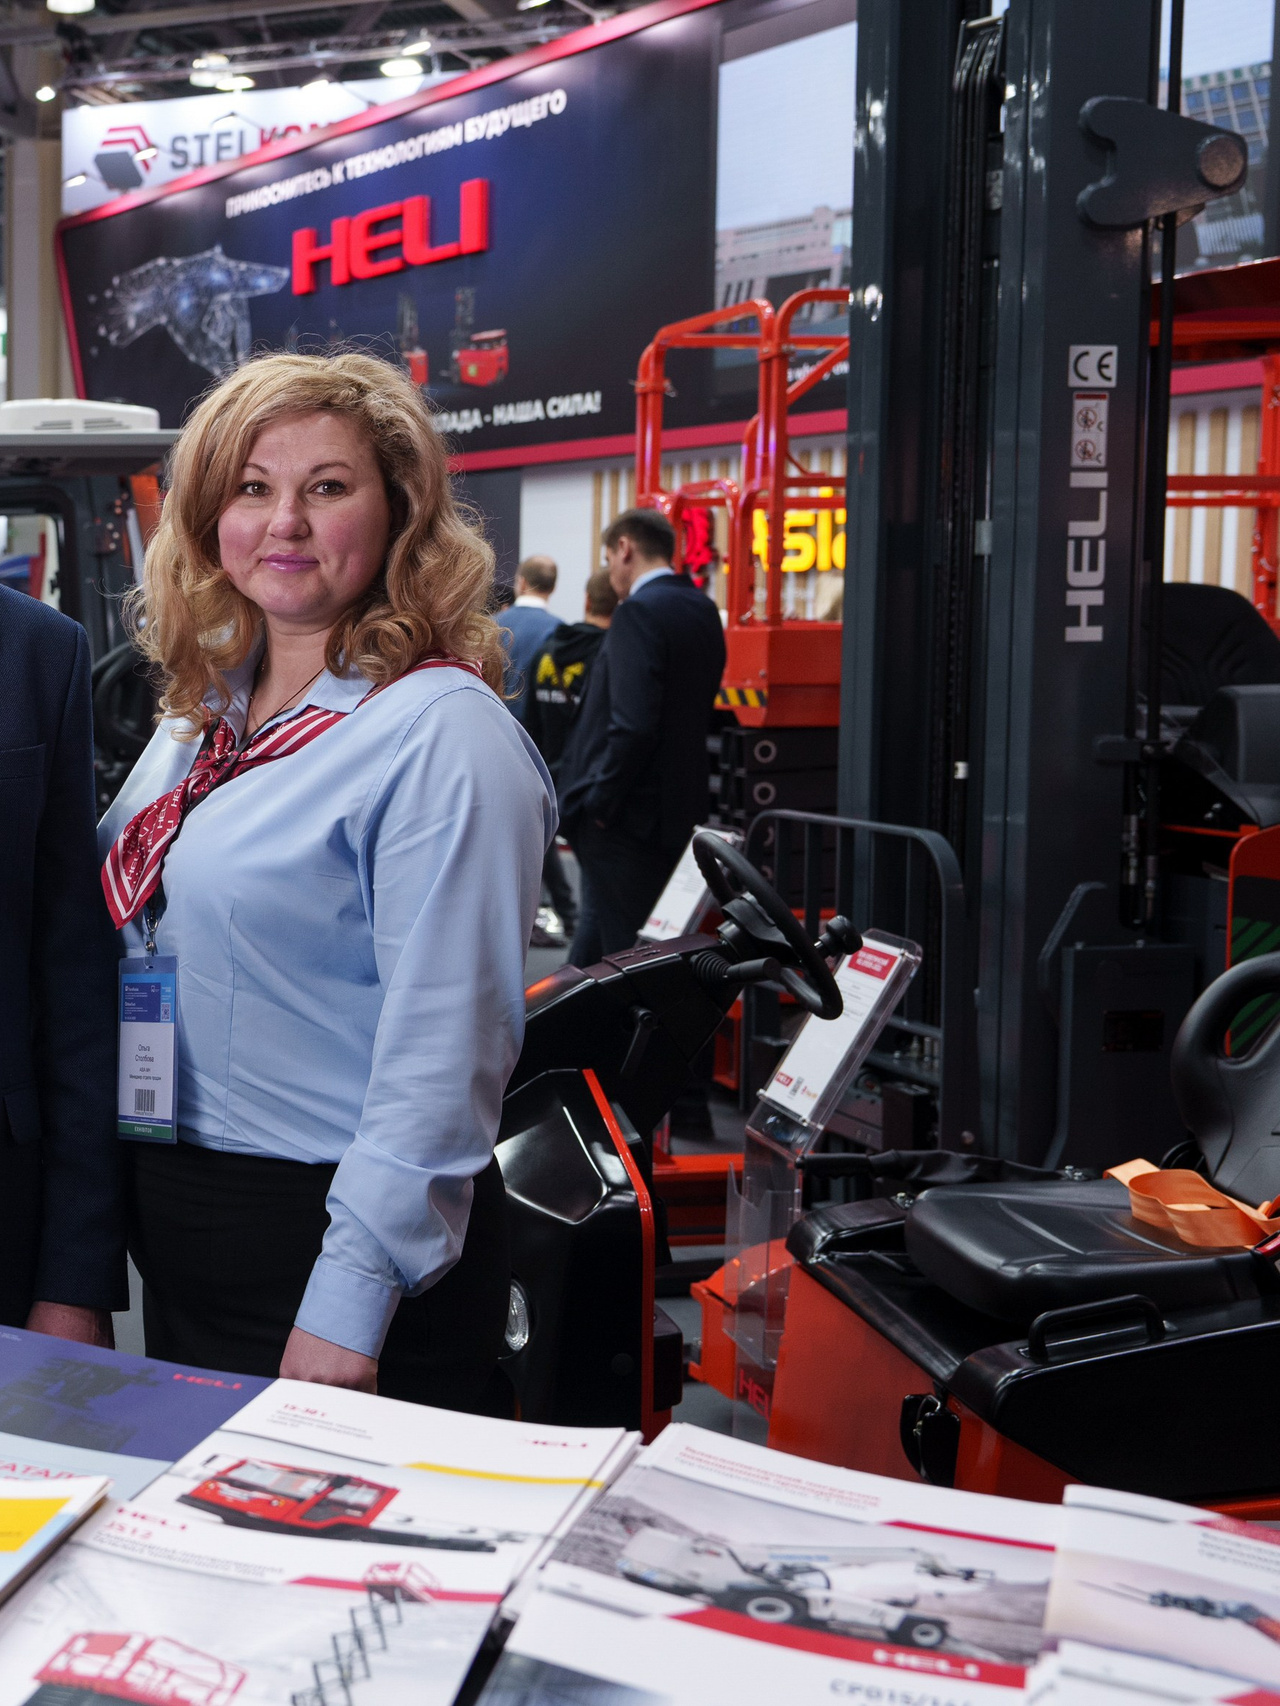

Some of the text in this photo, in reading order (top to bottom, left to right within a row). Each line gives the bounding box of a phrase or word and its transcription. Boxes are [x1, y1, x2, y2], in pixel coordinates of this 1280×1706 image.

[225, 168, 332, 218] ПРИКОСНИТЕСЬ
[346, 122, 463, 181] ТЕХНОЛОГИЯМ
[463, 88, 568, 144] БУДУЩЕГО
[292, 178, 489, 295] HELI
[1073, 351, 1113, 382] CE
[493, 399, 545, 427] НАША
[546, 390, 602, 419] СИЛА!
[1065, 471, 1108, 642] HELI
[171, 782, 184, 807] HELI
[172, 1372, 242, 1390] HELI
[873, 1649, 980, 1679] HELI
